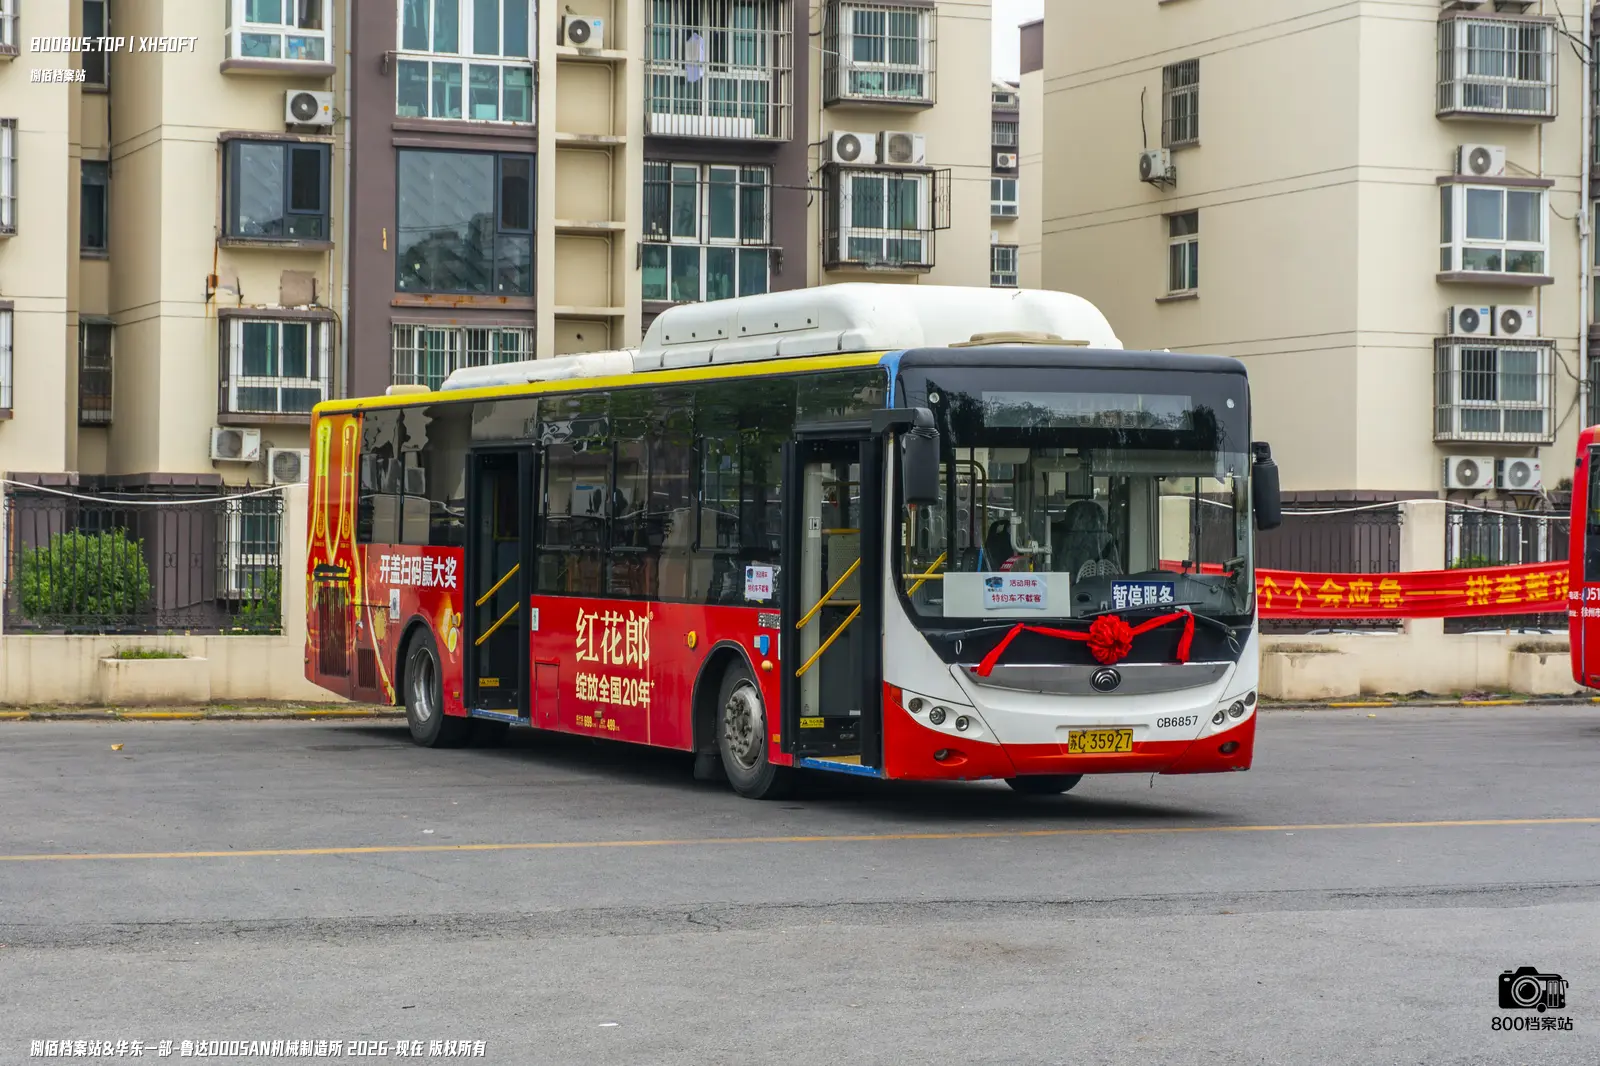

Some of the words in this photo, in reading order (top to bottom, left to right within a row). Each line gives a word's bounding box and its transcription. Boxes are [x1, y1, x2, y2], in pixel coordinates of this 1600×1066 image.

[379, 555, 457, 589] 开盖扫码赢大奖
[1009, 579, 1038, 587] 活动用车
[991, 593, 1042, 603] 特约车不载客
[1112, 583, 1174, 609] 暂停服务
[1157, 715, 1198, 728] CB6857
